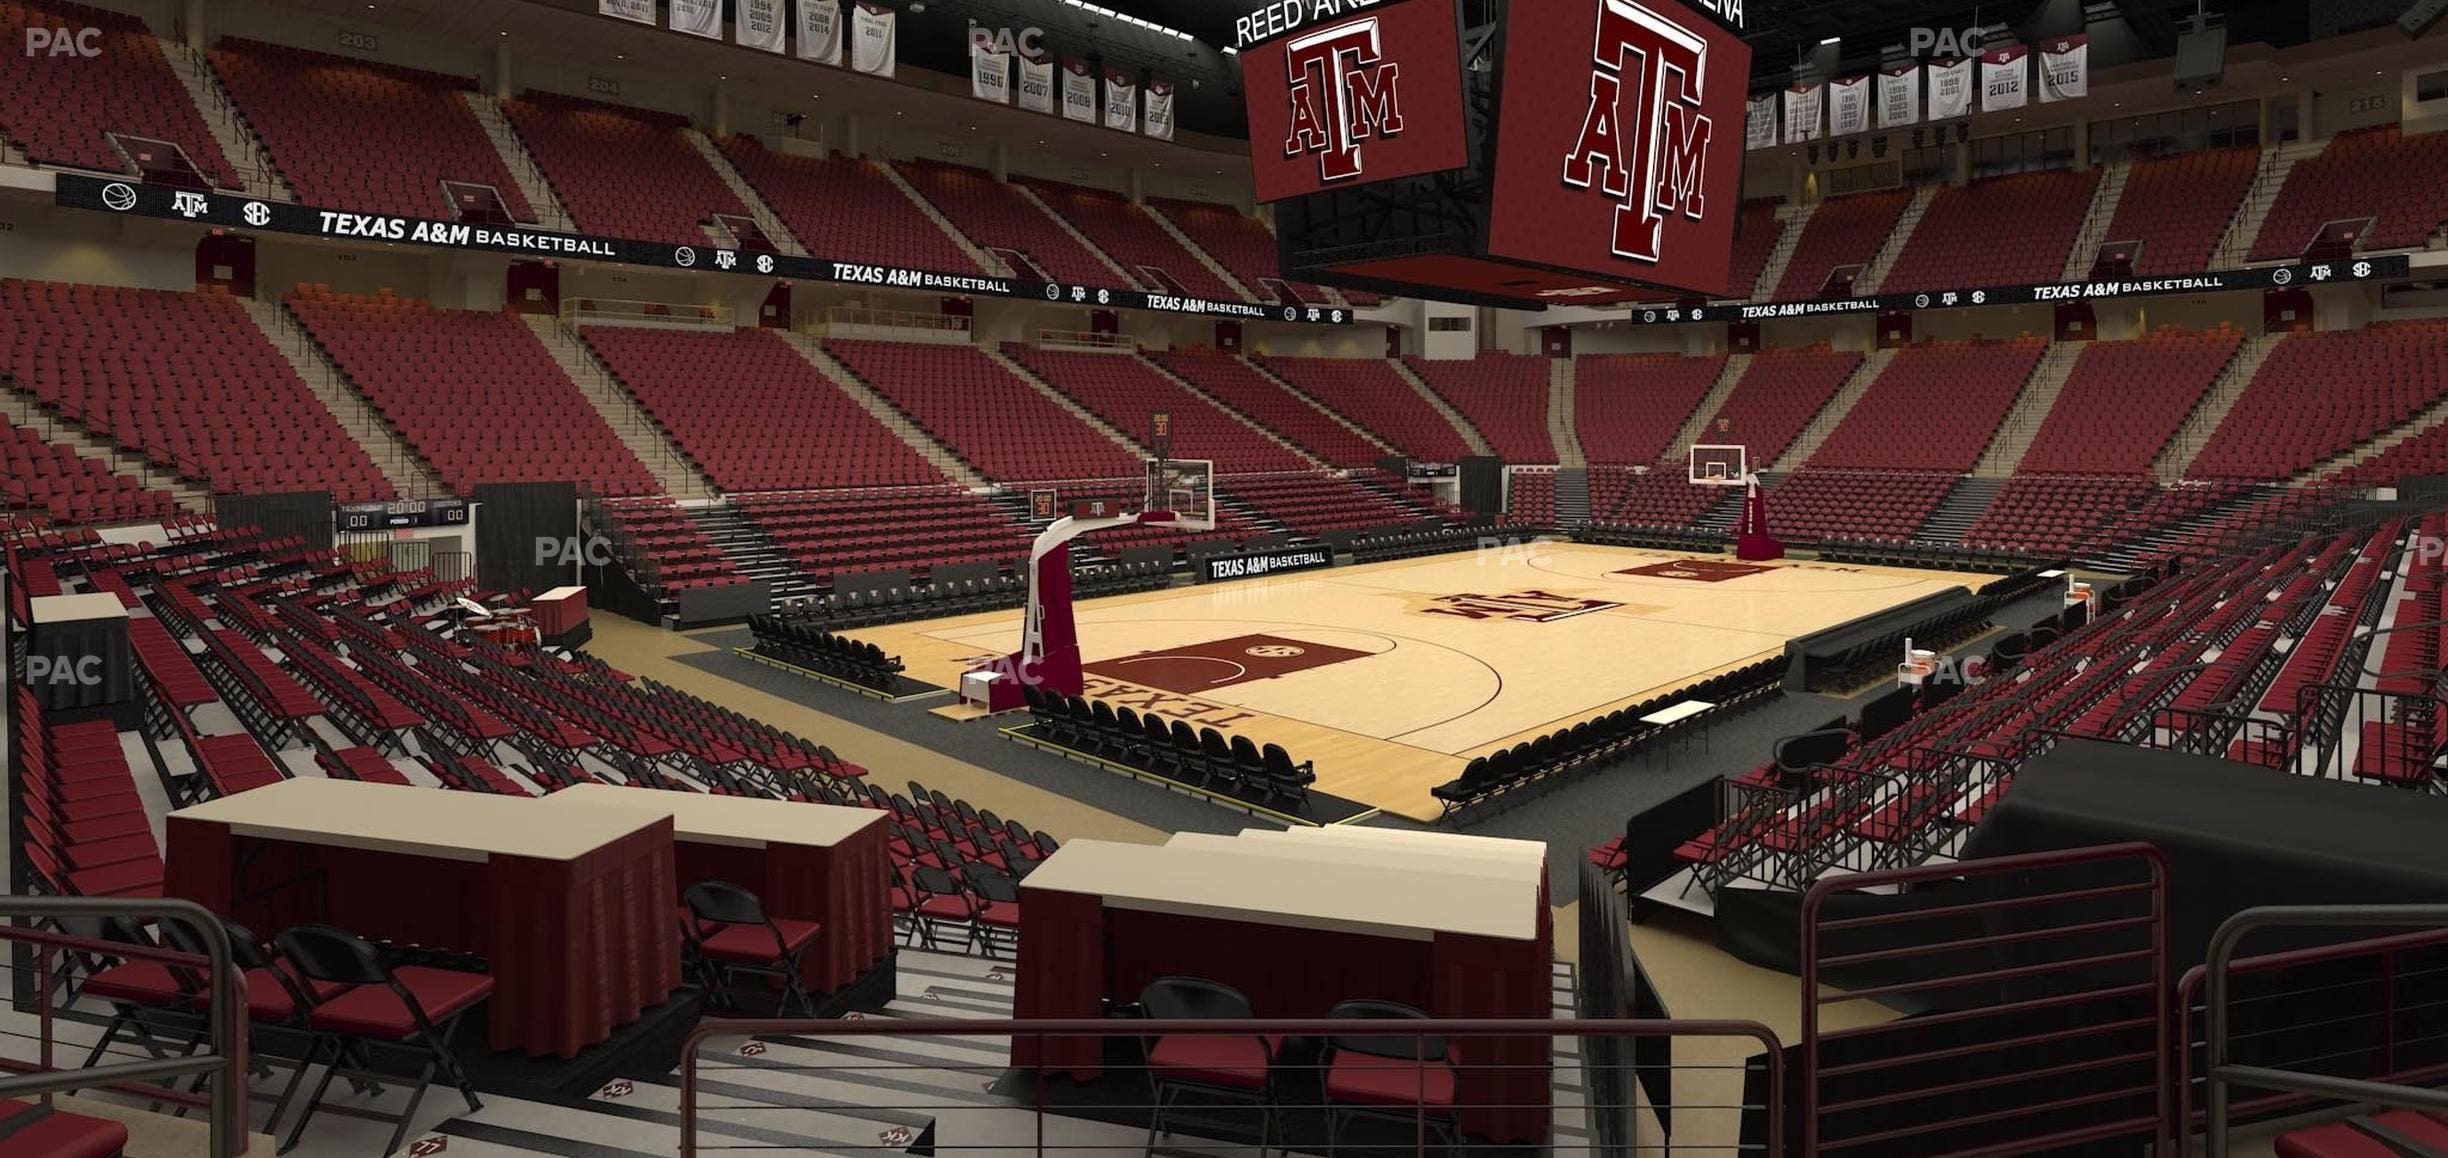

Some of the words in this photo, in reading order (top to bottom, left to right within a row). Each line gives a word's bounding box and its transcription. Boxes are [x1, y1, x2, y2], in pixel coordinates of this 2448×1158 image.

[751, 21, 771, 33] 2012
[809, 22, 829, 35] 2014
[1236, 0, 1302, 47] REED
[865, 27, 882, 38] 2011
[2048, 71, 2079, 87] 2015
[1024, 80, 1049, 96] 2007
[1990, 82, 2018, 97] 2012
[1111, 102, 1130, 117] 2010
[320, 211, 407, 240] TEXAS
[412, 222, 471, 246] A&M
[477, 230, 617, 256] BASKETBALL
[834, 263, 885, 284] TEXAS
[887, 266, 923, 287] A&M
[925, 274, 1010, 294] BASKETBALL
[2033, 285, 2081, 301] TEXAS
[2083, 281, 2119, 297] A&M
[2122, 276, 2222, 292] BASKETBALL
[1146, 294, 1180, 310] TEXAS
[1182, 297, 1205, 313] A&M
[1206, 302, 1265, 317] BASKETBALL
[1742, 305, 1777, 318] TEXAS
[1778, 303, 1804, 316] A&M
[1807, 299, 1879, 312] BASKETBALL
[1212, 558, 1245, 579] TEXAS
[1246, 555, 1268, 575] A&M
[1269, 551, 1326, 568] BASKETBALL
